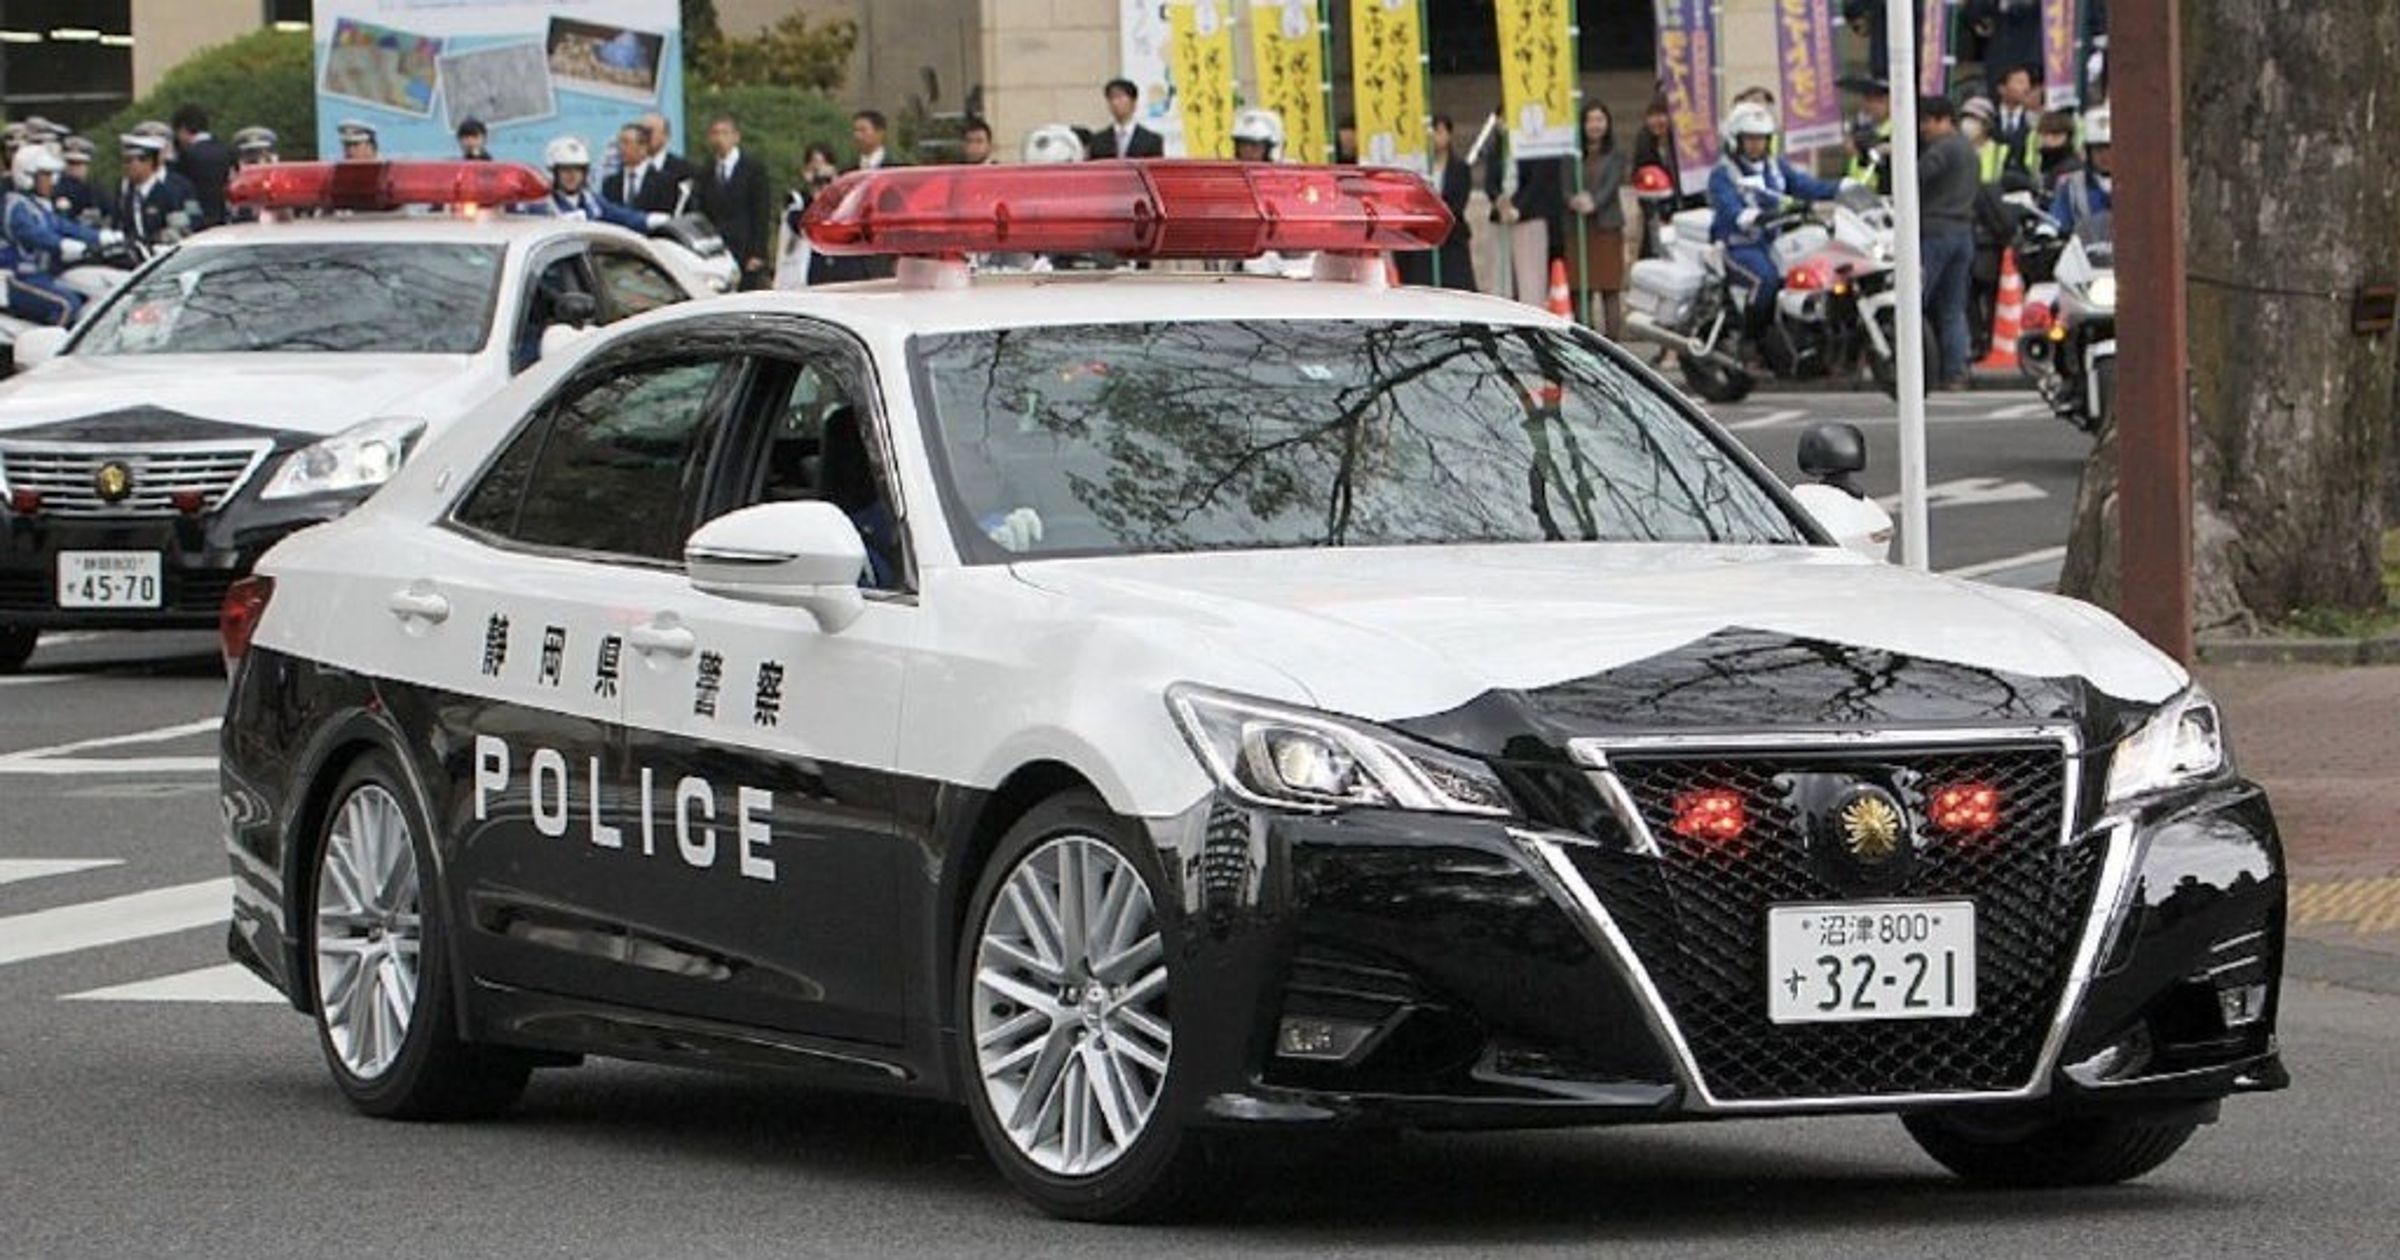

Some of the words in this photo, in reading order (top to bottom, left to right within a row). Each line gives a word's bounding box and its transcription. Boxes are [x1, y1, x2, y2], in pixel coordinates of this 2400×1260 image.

[81, 575, 154, 601] 45-70
[474, 734, 777, 882] POLICE
[1819, 912, 1929, 947] 沼津800
[1782, 967, 1808, 1001] す
[1815, 950, 1956, 1011] 32-21
